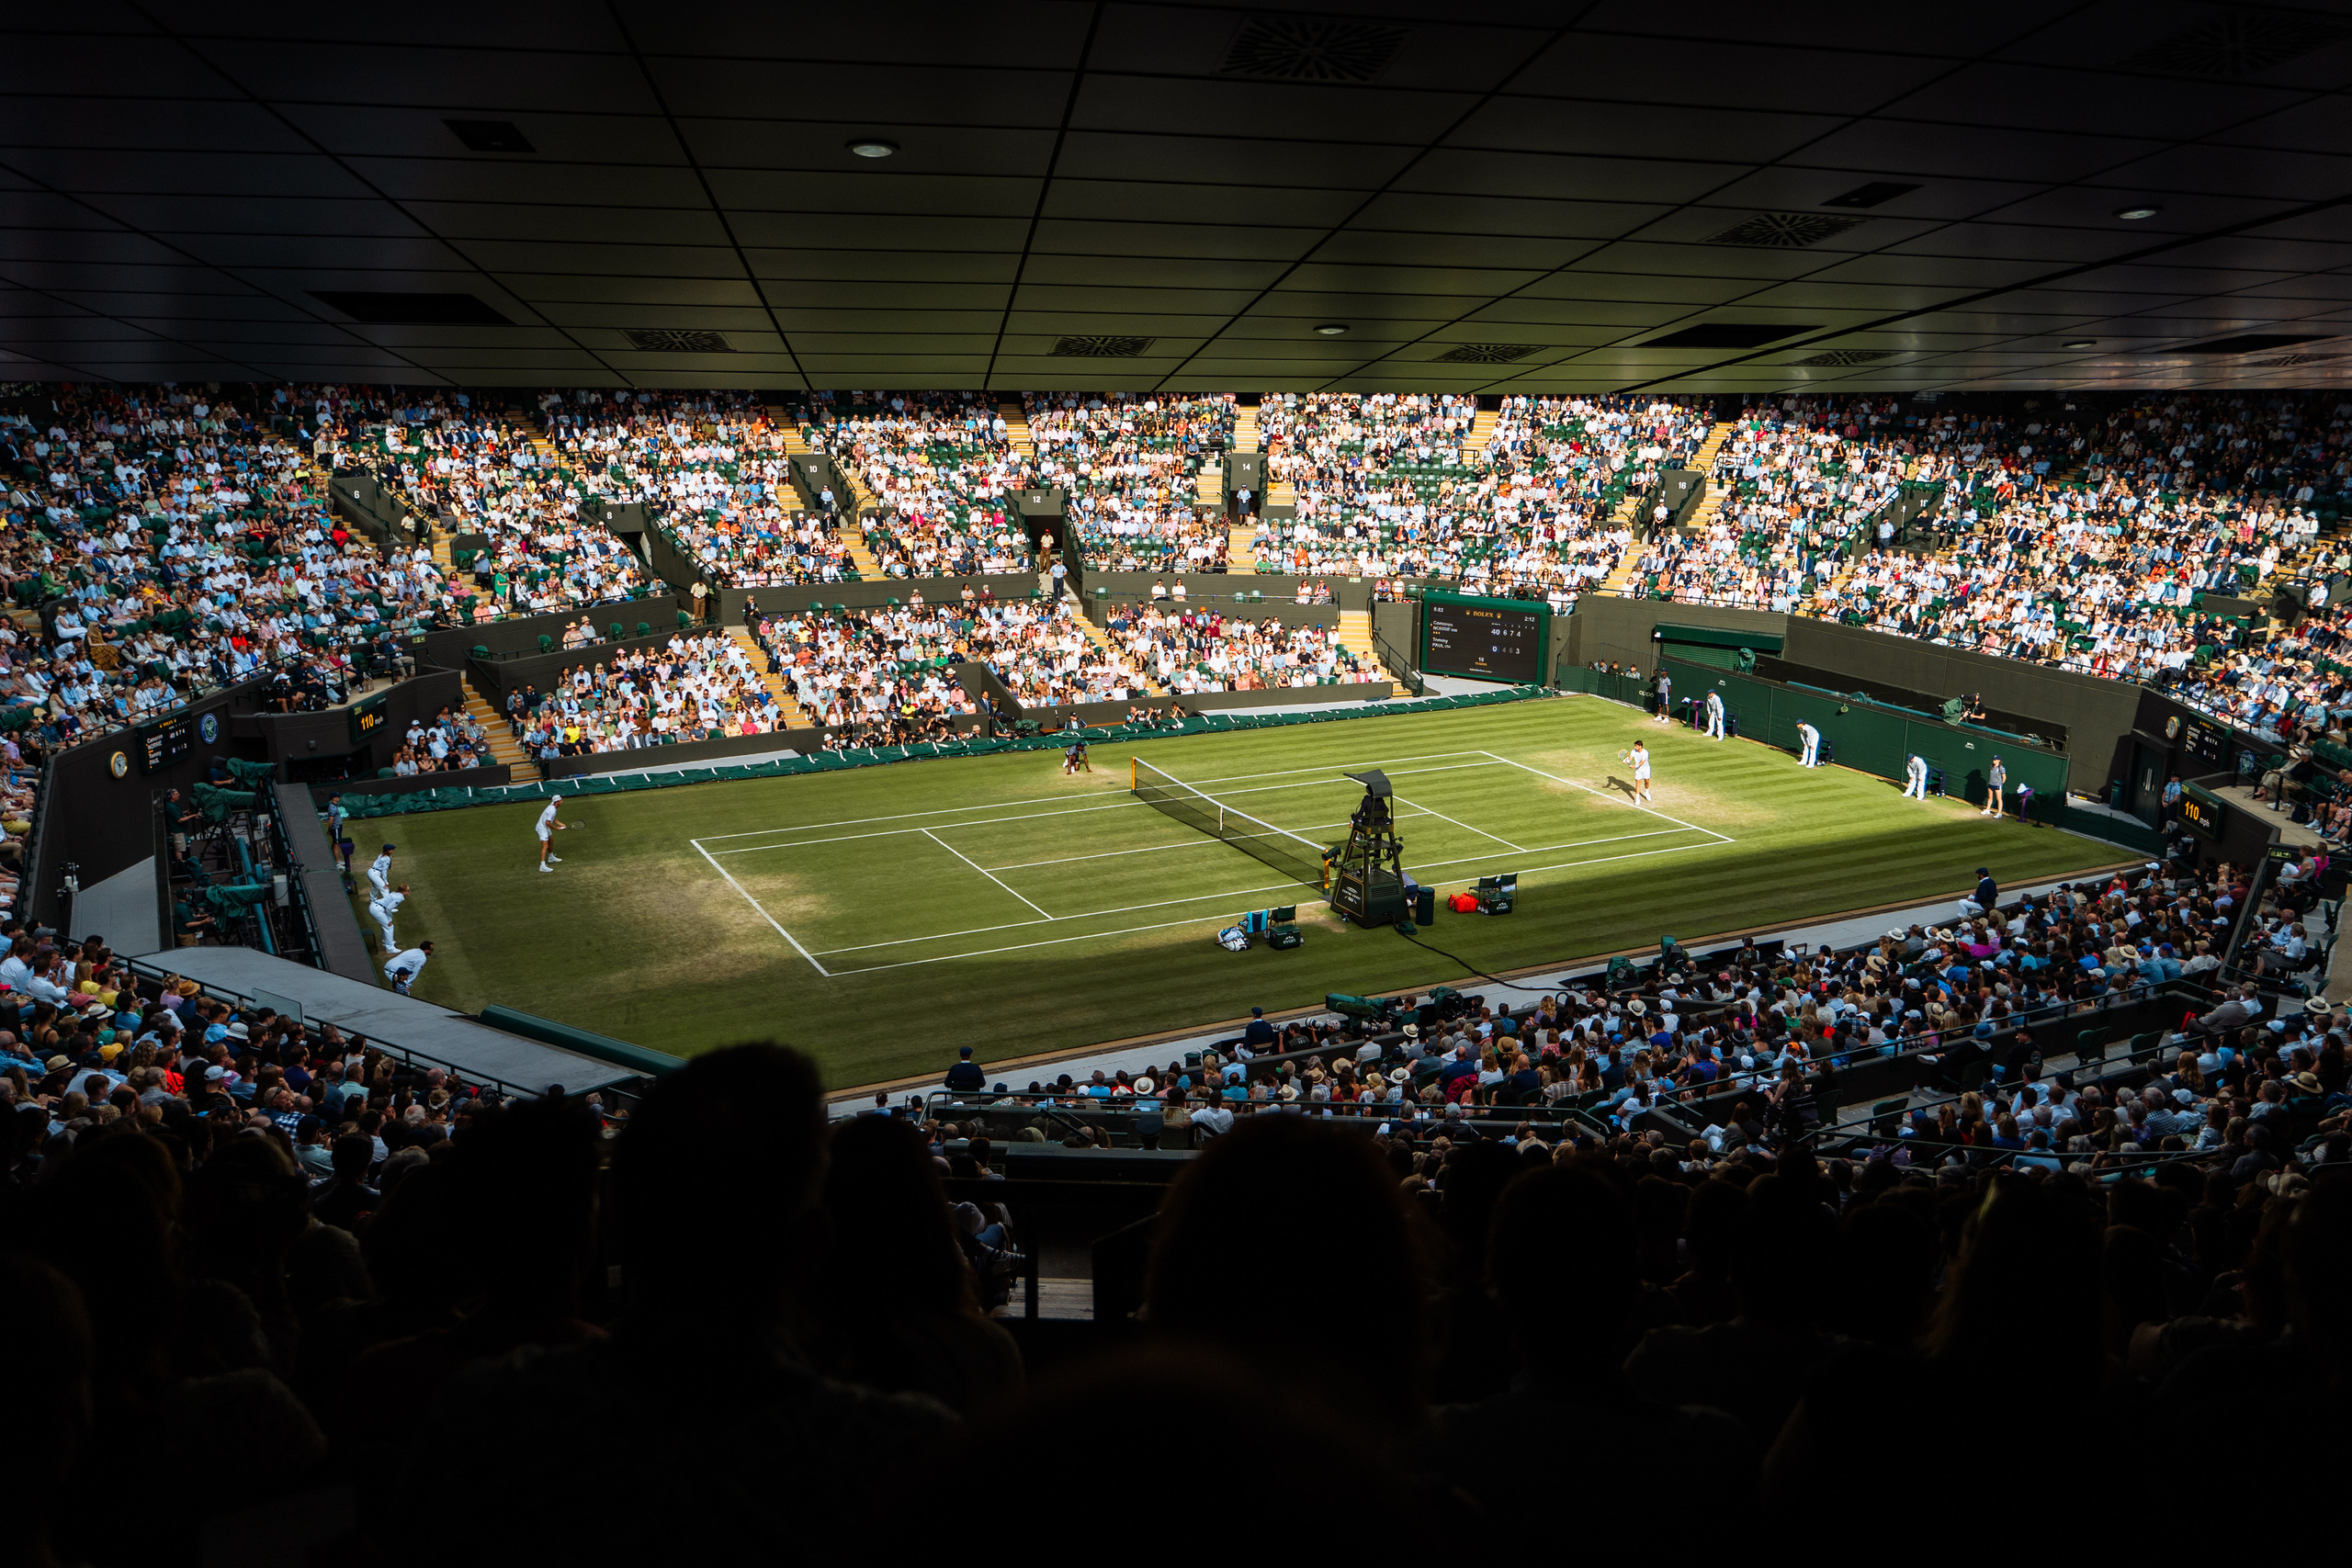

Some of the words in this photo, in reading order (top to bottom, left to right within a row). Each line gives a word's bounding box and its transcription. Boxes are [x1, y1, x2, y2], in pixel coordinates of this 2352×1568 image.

[808, 465, 818, 473] 10
[1242, 463, 1251, 471] 14
[1678, 481, 1687, 490] 16
[354, 490, 360, 499] 6
[1033, 495, 1042, 503] 12
[606, 511, 613, 520] 8
[1639, 690, 1655, 698] oppo
[360, 714, 374, 730] 110
[375, 715, 384, 725] mph
[147, 734, 164, 744] Cameron
[2185, 801, 2199, 820] 110
[2199, 817, 2210, 828] mph
